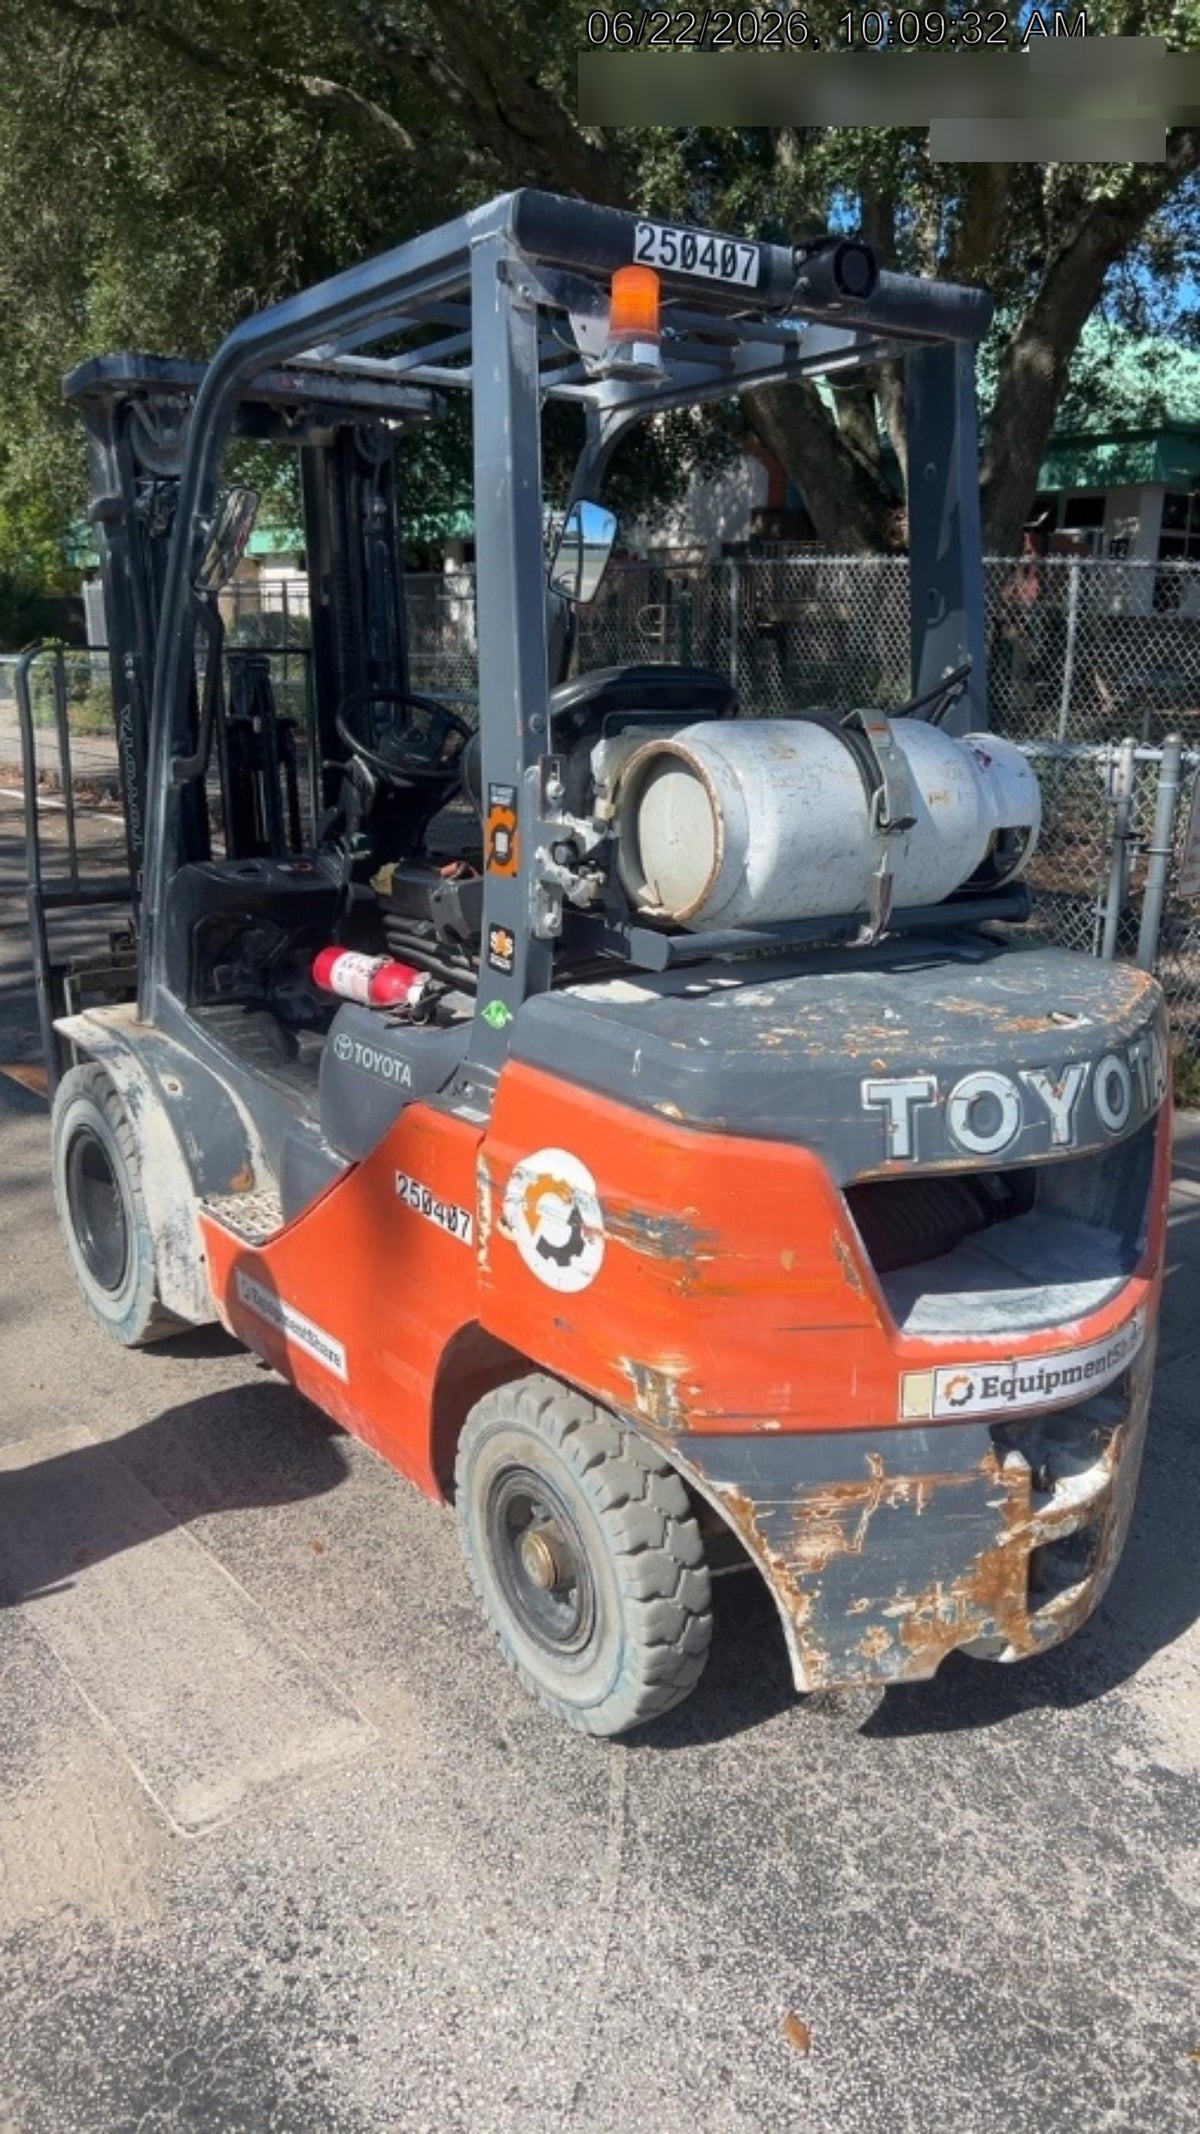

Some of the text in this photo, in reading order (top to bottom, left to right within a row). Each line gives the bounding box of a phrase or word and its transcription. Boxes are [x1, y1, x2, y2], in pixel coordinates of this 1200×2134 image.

[637, 224, 757, 282] 250407
[354, 1043, 412, 1087] TOYOTA
[861, 1031, 1166, 1162] TOYOTA
[398, 1174, 470, 1239] 250407
[981, 1325, 1139, 1401] EquipmentS
